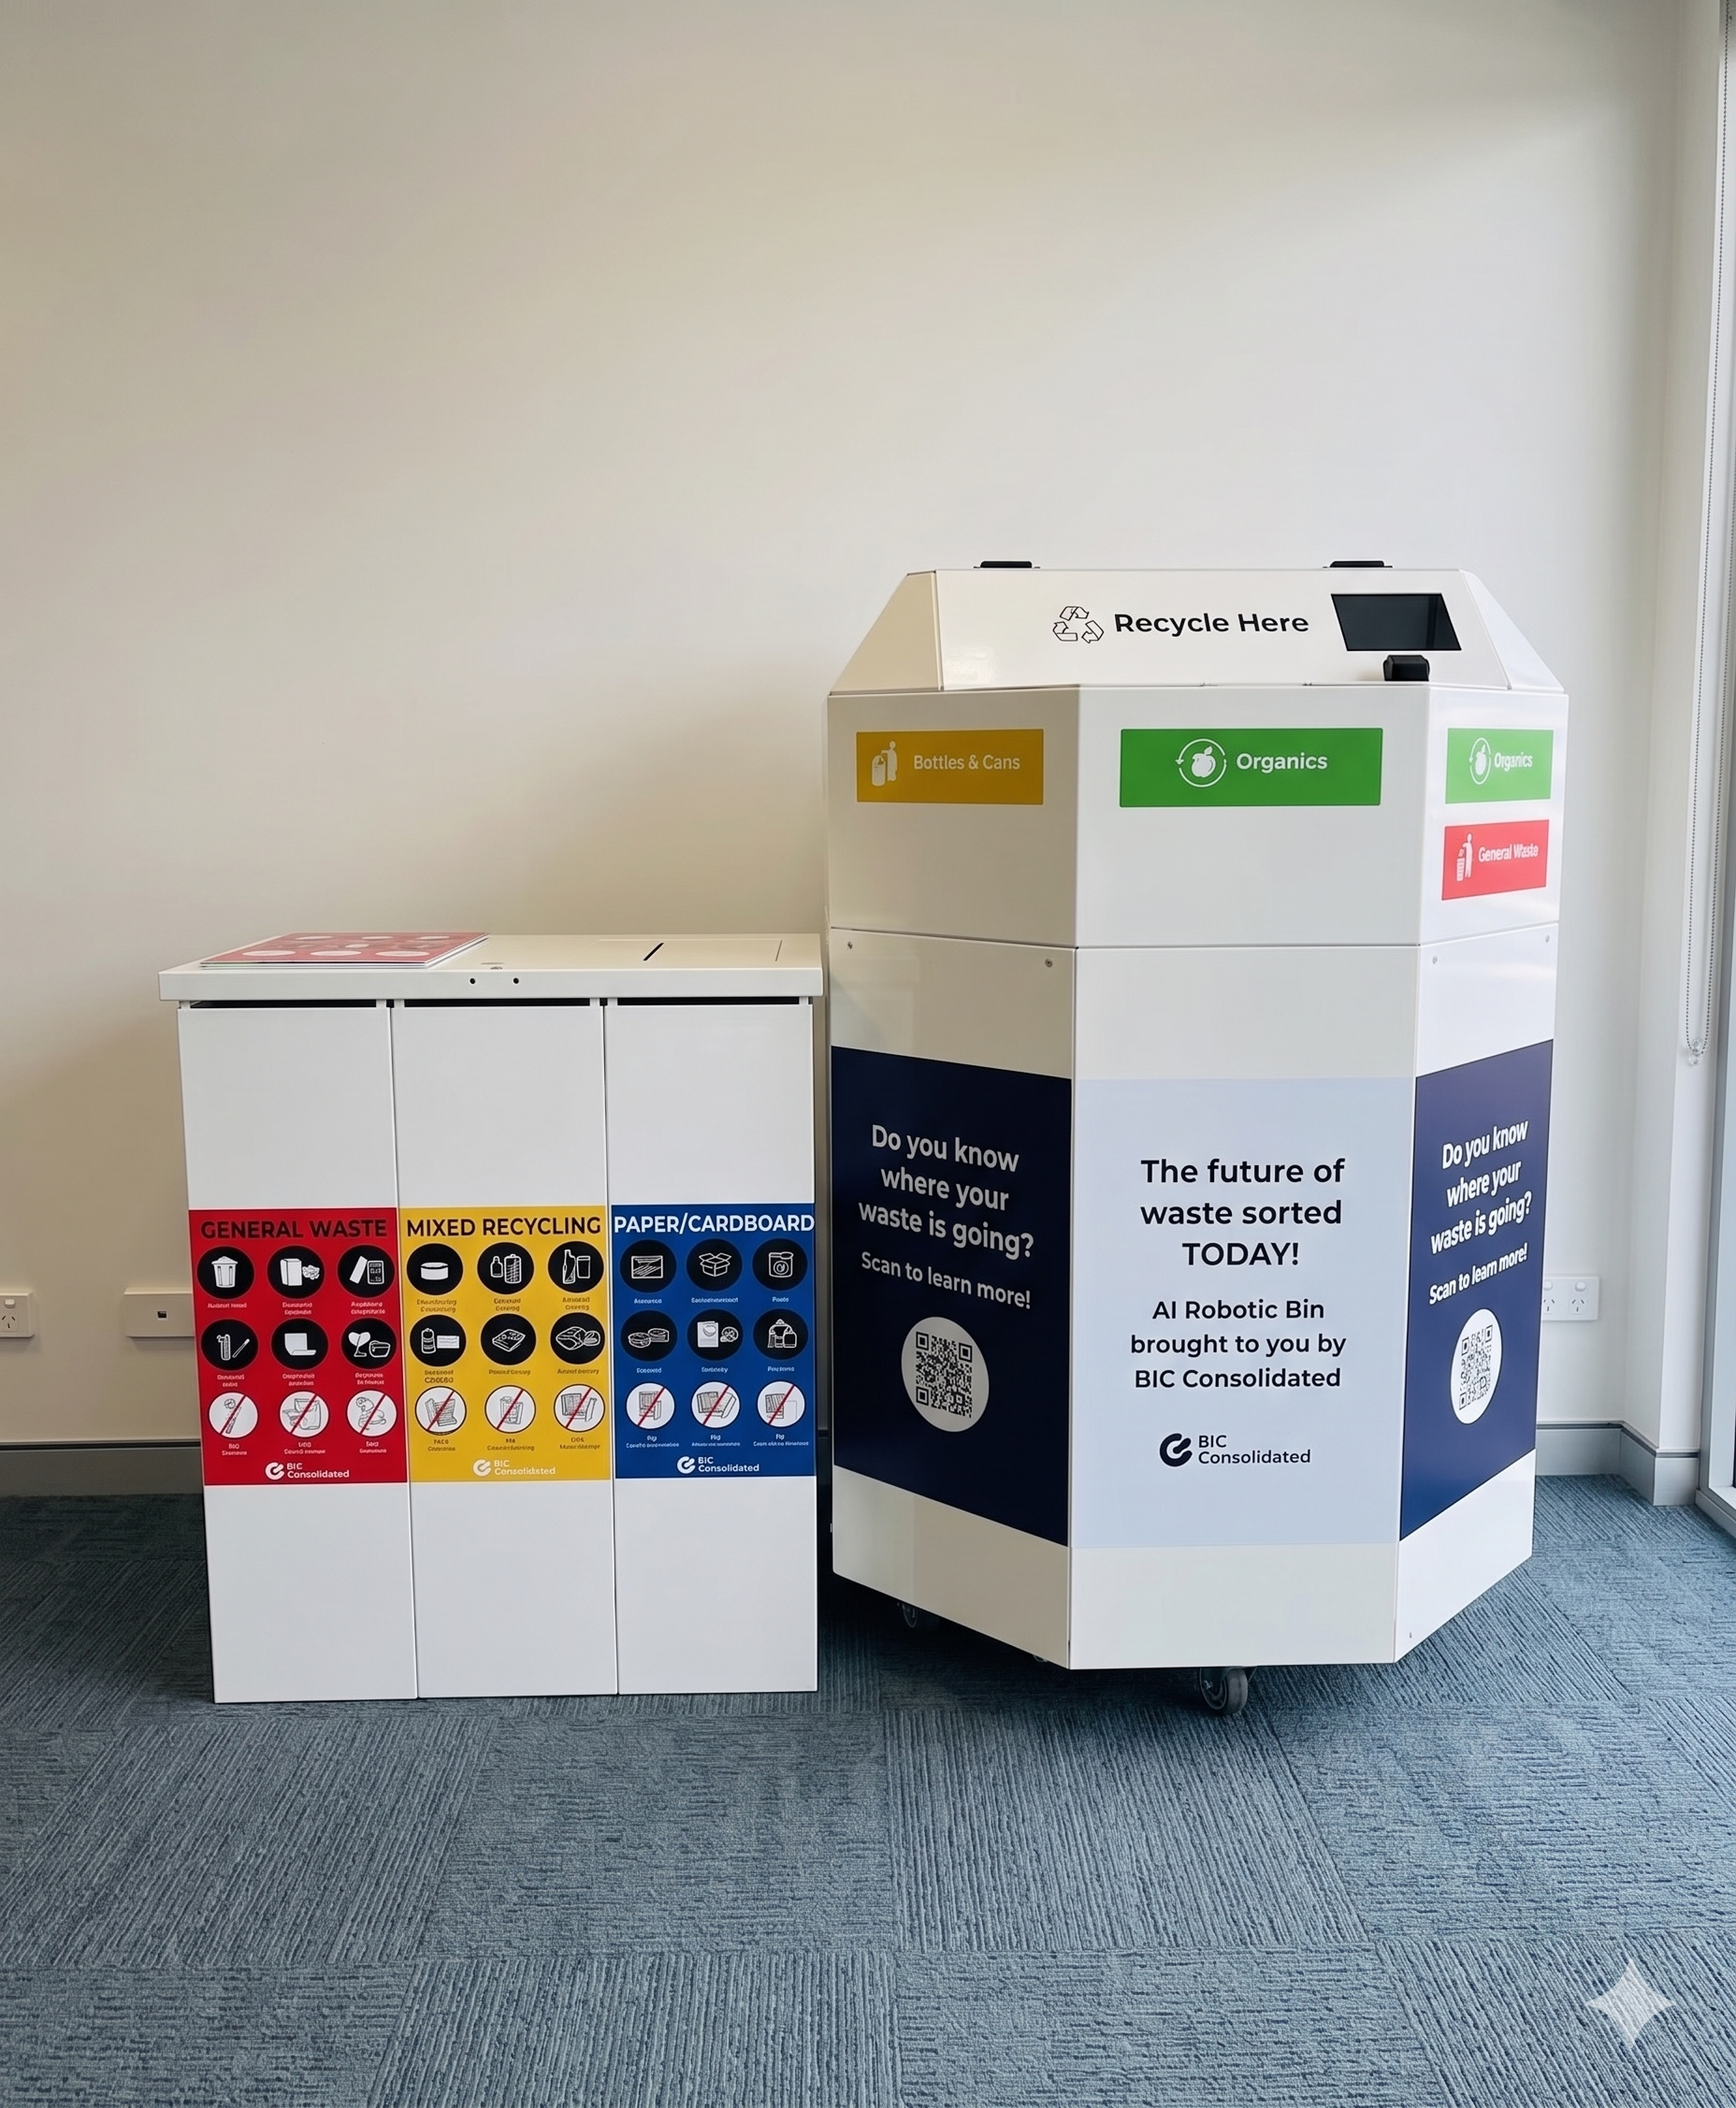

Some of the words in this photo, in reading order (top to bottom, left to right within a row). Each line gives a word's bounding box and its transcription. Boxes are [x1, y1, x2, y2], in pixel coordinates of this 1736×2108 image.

[1114, 613, 1229, 637] Recycle
[1237, 614, 1309, 632] Here
[914, 755, 964, 771] Bottles
[968, 755, 978, 771] &
[982, 755, 1020, 770] Cans
[1236, 752, 1328, 773] Organics
[1494, 752, 1533, 772] Organics
[1478, 844, 1512, 862] General
[872, 1124, 901, 1150] Do
[906, 1134, 948, 1160] you
[955, 1136, 1020, 1172] know
[1442, 1143, 1462, 1169] Do
[1464, 1134, 1490, 1167] you
[1493, 1120, 1528, 1151] know
[1141, 1159, 1198, 1183] The
[1208, 1158, 1304, 1183] future
[1313, 1158, 1345, 1183] of
[880, 1166, 949, 1199] where
[955, 1183, 1008, 1211] your
[1447, 1177, 1489, 1207] where
[1491, 1162, 1521, 1196] your
[1140, 1203, 1233, 1225] waste
[1242, 1199, 1341, 1225] sorted
[1430, 1220, 1471, 1254] waste
[1475, 1209, 1486, 1236] is
[1488, 1191, 1532, 1236] going?
[201, 1220, 304, 1239] GENERAL
[310, 1219, 387, 1237] WASTE
[407, 1218, 475, 1236] MIXED
[483, 1217, 600, 1235] RECYCLING
[615, 1213, 815, 1234] PAPER/CARDBOARD
[858, 1202, 922, 1233] waste
[929, 1210, 947, 1238] is
[952, 1221, 1034, 1260] going?
[1182, 1242, 1299, 1265] TODAY!
[861, 1251, 901, 1278] Scan
[905, 1263, 923, 1282] to
[928, 1266, 972, 1294] learn
[976, 1282, 1031, 1309] more!
[1429, 1278, 1456, 1305] Scan
[1458, 1274, 1470, 1291] to
[1471, 1261, 1497, 1286] learn
[1498, 1242, 1528, 1272] more!
[1152, 1301, 1177, 1320] AI
[1185, 1298, 1278, 1320] Robotic
[1286, 1298, 1324, 1319] Bin
[1131, 1334, 1228, 1358] brought
[1236, 1336, 1259, 1353] to
[1266, 1338, 1309, 1358] you
[1318, 1334, 1347, 1357] by
[1136, 1369, 1175, 1388] BIC
[1182, 1367, 1340, 1388] Consolidated
[1198, 1435, 1227, 1448] BIC
[1198, 1449, 1310, 1464] Consolidated
[286, 1470, 350, 1479] Consolidated
[698, 1464, 760, 1472] Consolidated
